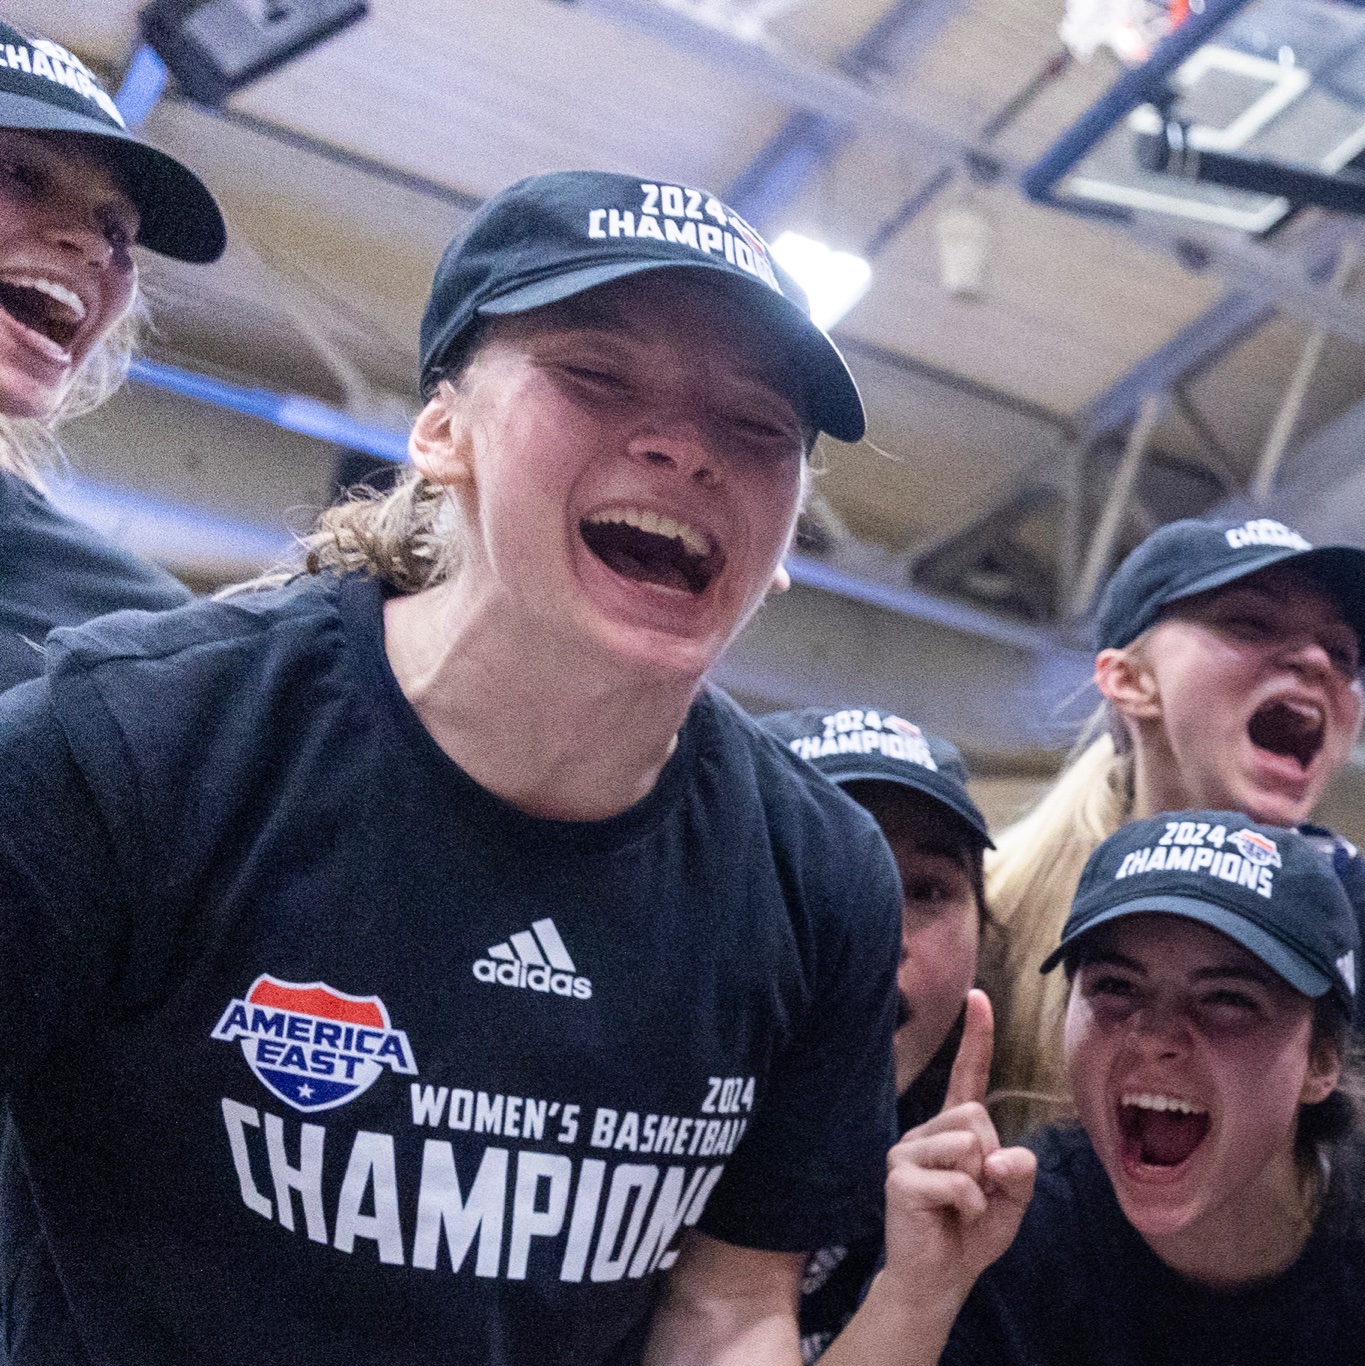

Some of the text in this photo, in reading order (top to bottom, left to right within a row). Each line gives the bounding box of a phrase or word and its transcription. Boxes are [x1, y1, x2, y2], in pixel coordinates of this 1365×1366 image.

[641, 183, 728, 227] 2024
[588, 208, 784, 297] CHAMPIO
[1158, 821, 1227, 849] 2024
[1115, 846, 1274, 899] CHAMPIONS
[472, 957, 593, 1000] adidas
[220, 1004, 405, 1071] AMERICA
[255, 1039, 366, 1079] EAST
[411, 1083, 580, 1144] WOMEN'S
[702, 1077, 756, 1114] 2024
